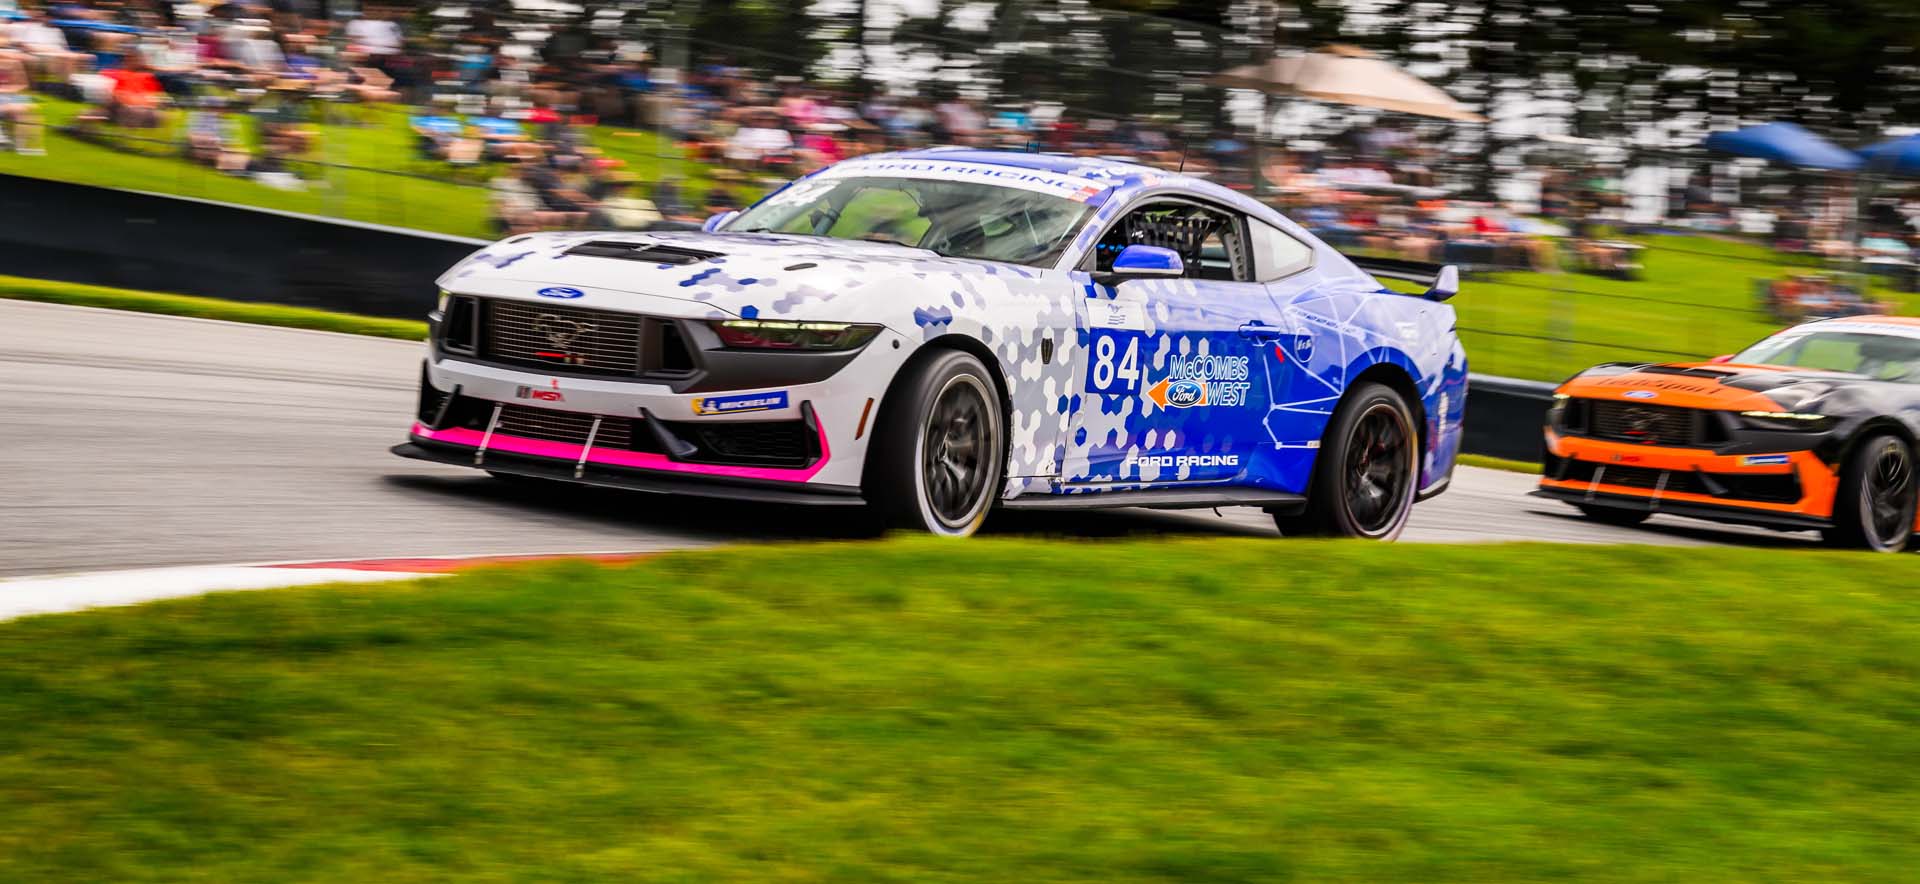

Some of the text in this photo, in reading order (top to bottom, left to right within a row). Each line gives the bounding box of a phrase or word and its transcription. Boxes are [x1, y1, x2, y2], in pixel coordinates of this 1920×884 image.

[1093, 335, 1140, 391] 84
[1169, 354, 1249, 381] McCOMBS
[719, 397, 782, 410] MICHELIN
[1172, 384, 1196, 402] Ford
[1206, 381, 1251, 406] WEST
[1127, 455, 1239, 467] FORD RACING
